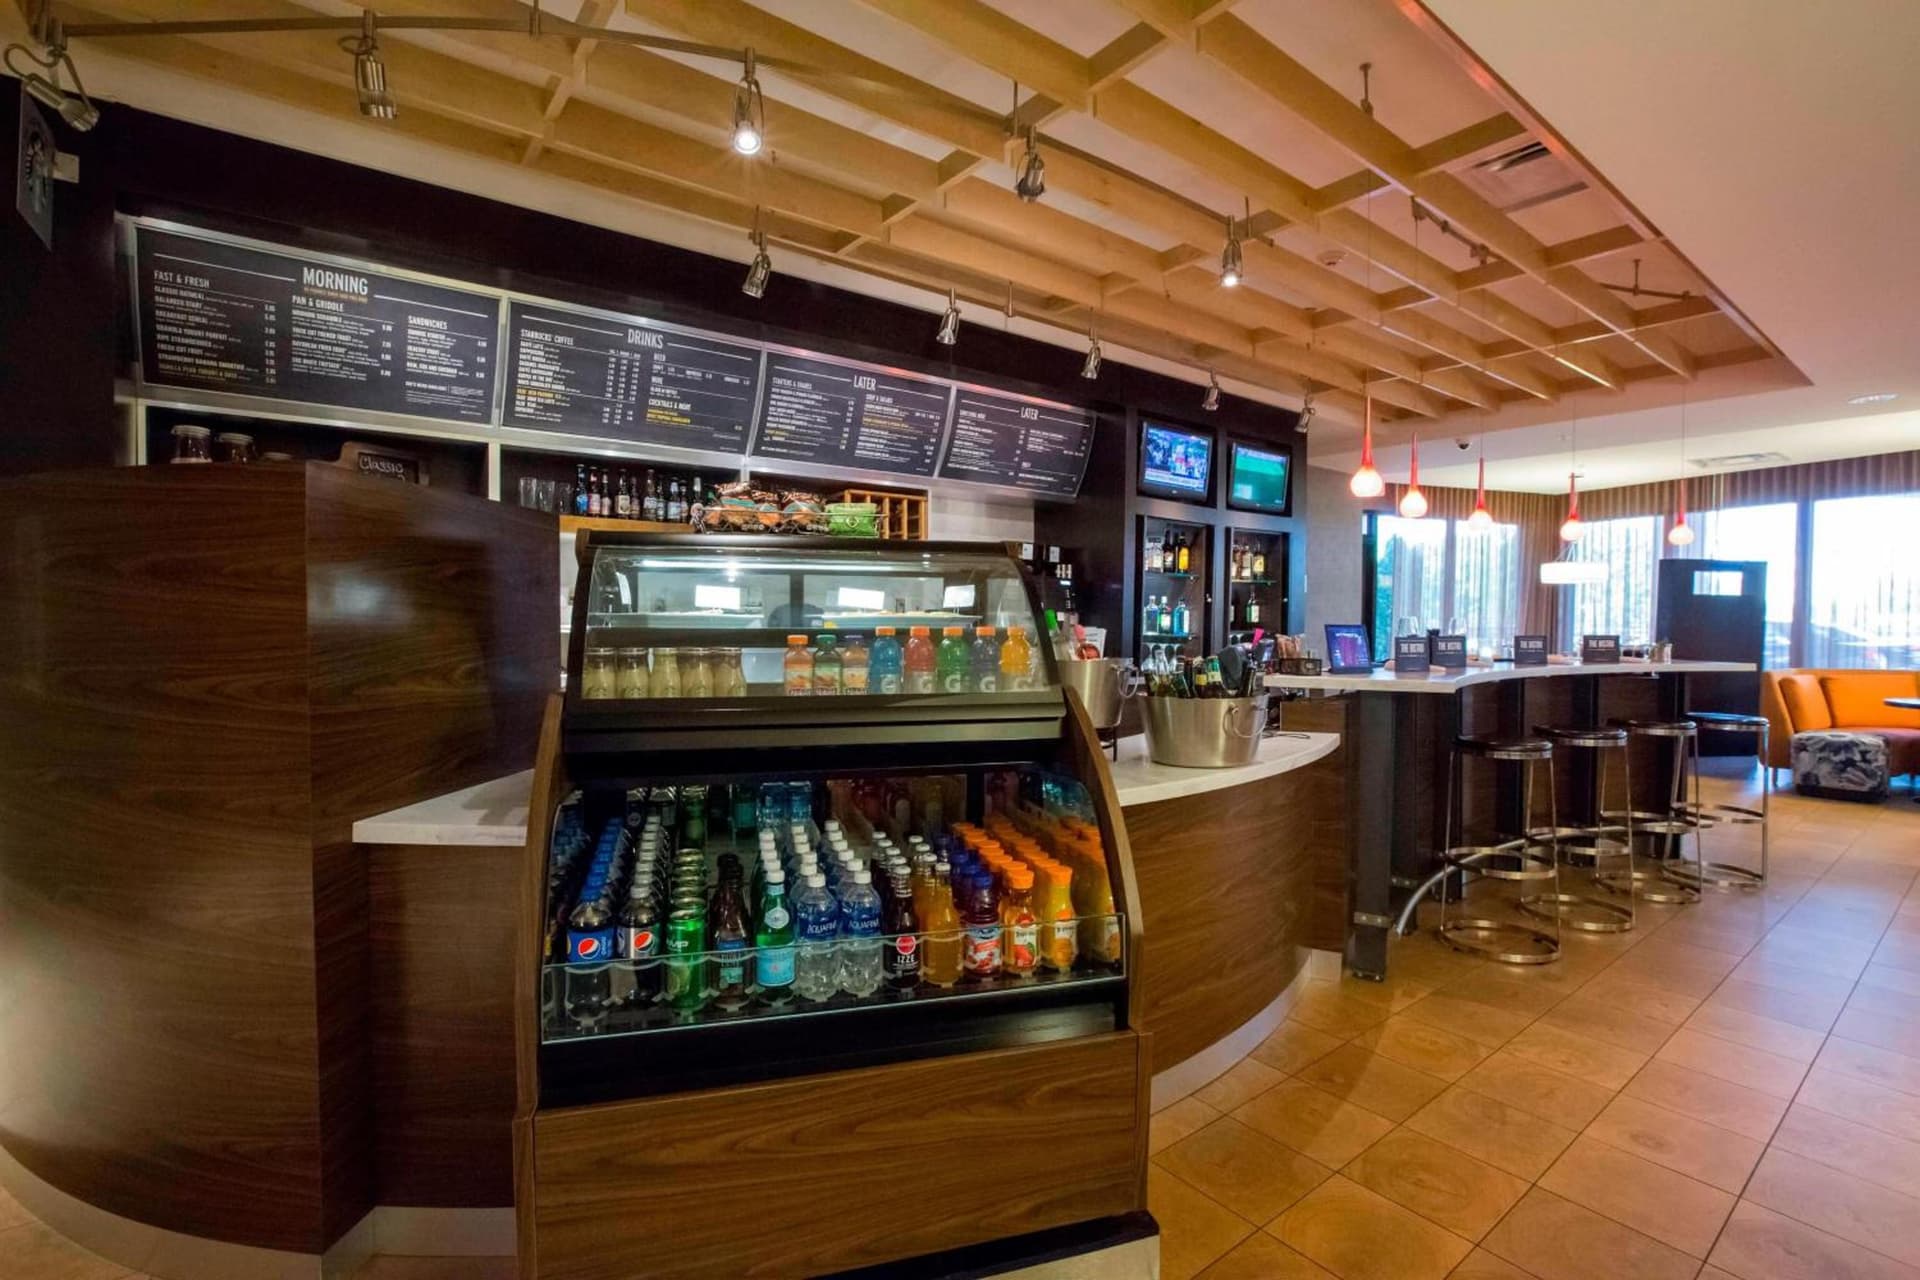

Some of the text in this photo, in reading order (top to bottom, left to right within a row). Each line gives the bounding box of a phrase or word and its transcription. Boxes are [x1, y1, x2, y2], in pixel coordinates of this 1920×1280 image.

[154, 270, 209, 288] FAST & FRESH
[303, 266, 368, 295] MORNING
[292, 295, 306, 306] PAN
[308, 298, 314, 307] &
[316, 299, 344, 312] GRIDDLE
[408, 315, 448, 330] SANDWICHES
[521, 328, 574, 346] STARBUCKS COFFEE
[628, 328, 664, 349] DRINKS
[853, 374, 877, 391] LATER
[649, 399, 672, 409] COCKTAILS
[1020, 406, 1039, 420] LATER
[360, 456, 404, 473] Classic
[945, 674, 961, 693] G
[980, 676, 996, 693] G
[897, 955, 914, 964] IZZE
